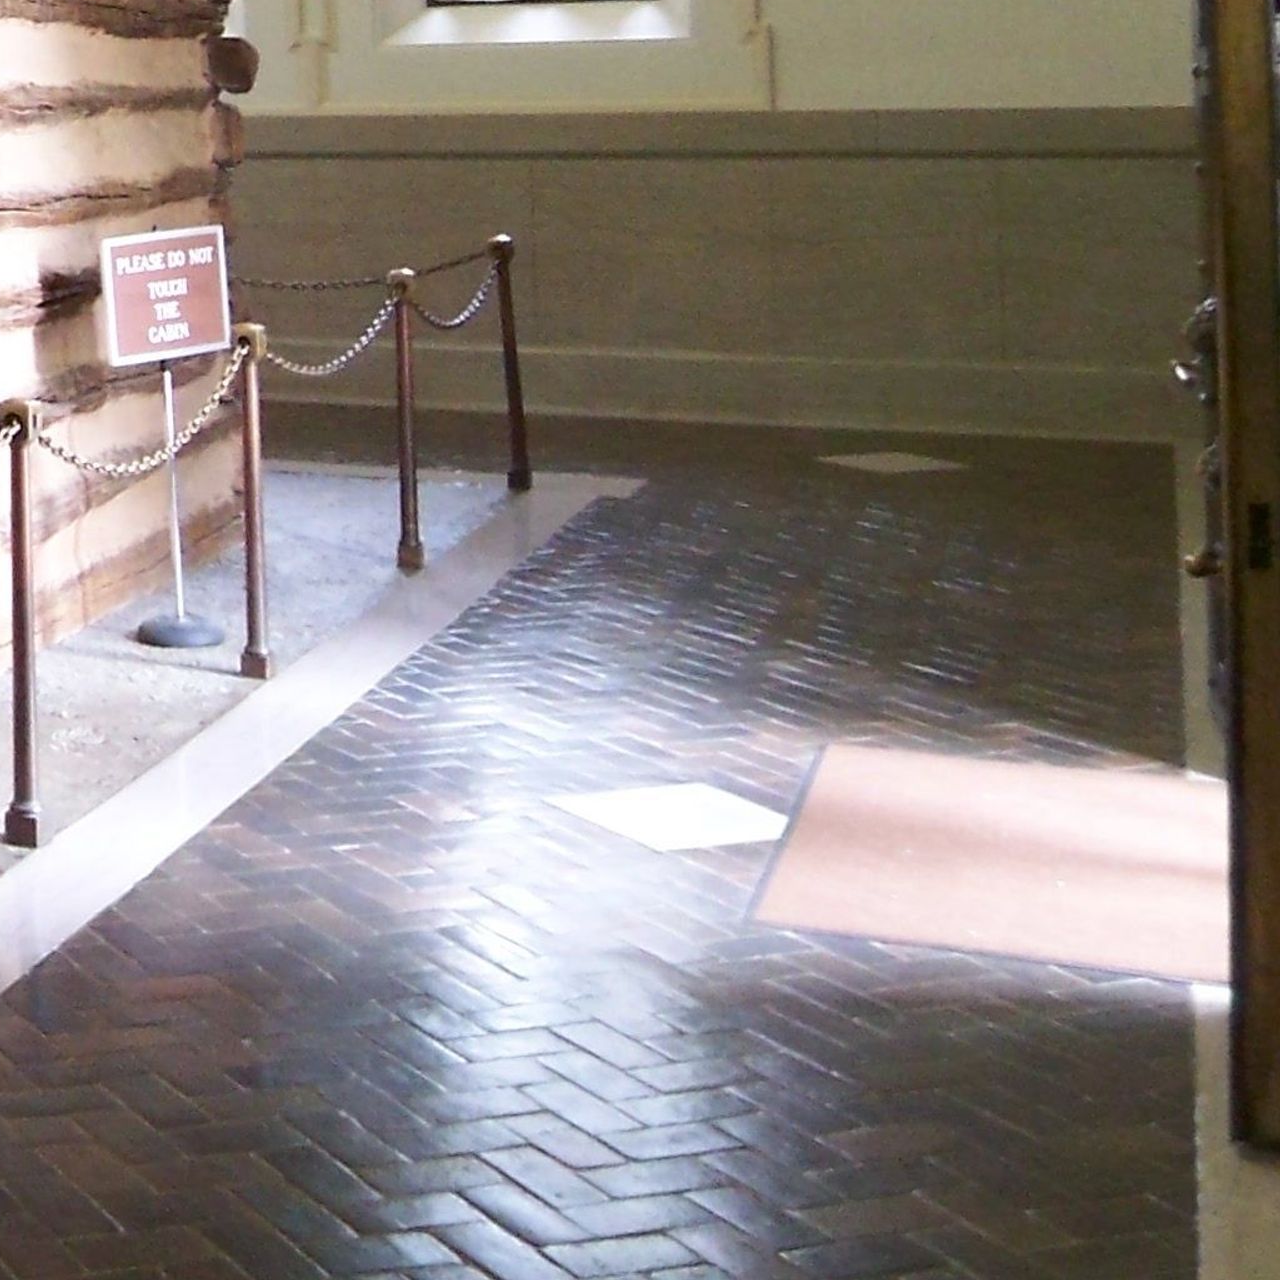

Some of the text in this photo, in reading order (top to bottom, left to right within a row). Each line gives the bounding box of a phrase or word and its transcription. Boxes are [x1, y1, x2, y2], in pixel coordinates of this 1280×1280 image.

[116, 246, 214, 276] PLEASE DO NOT
[147, 278, 188, 300] TOUCH
[153, 301, 180, 320] THE
[148, 322, 190, 344] CABIN
